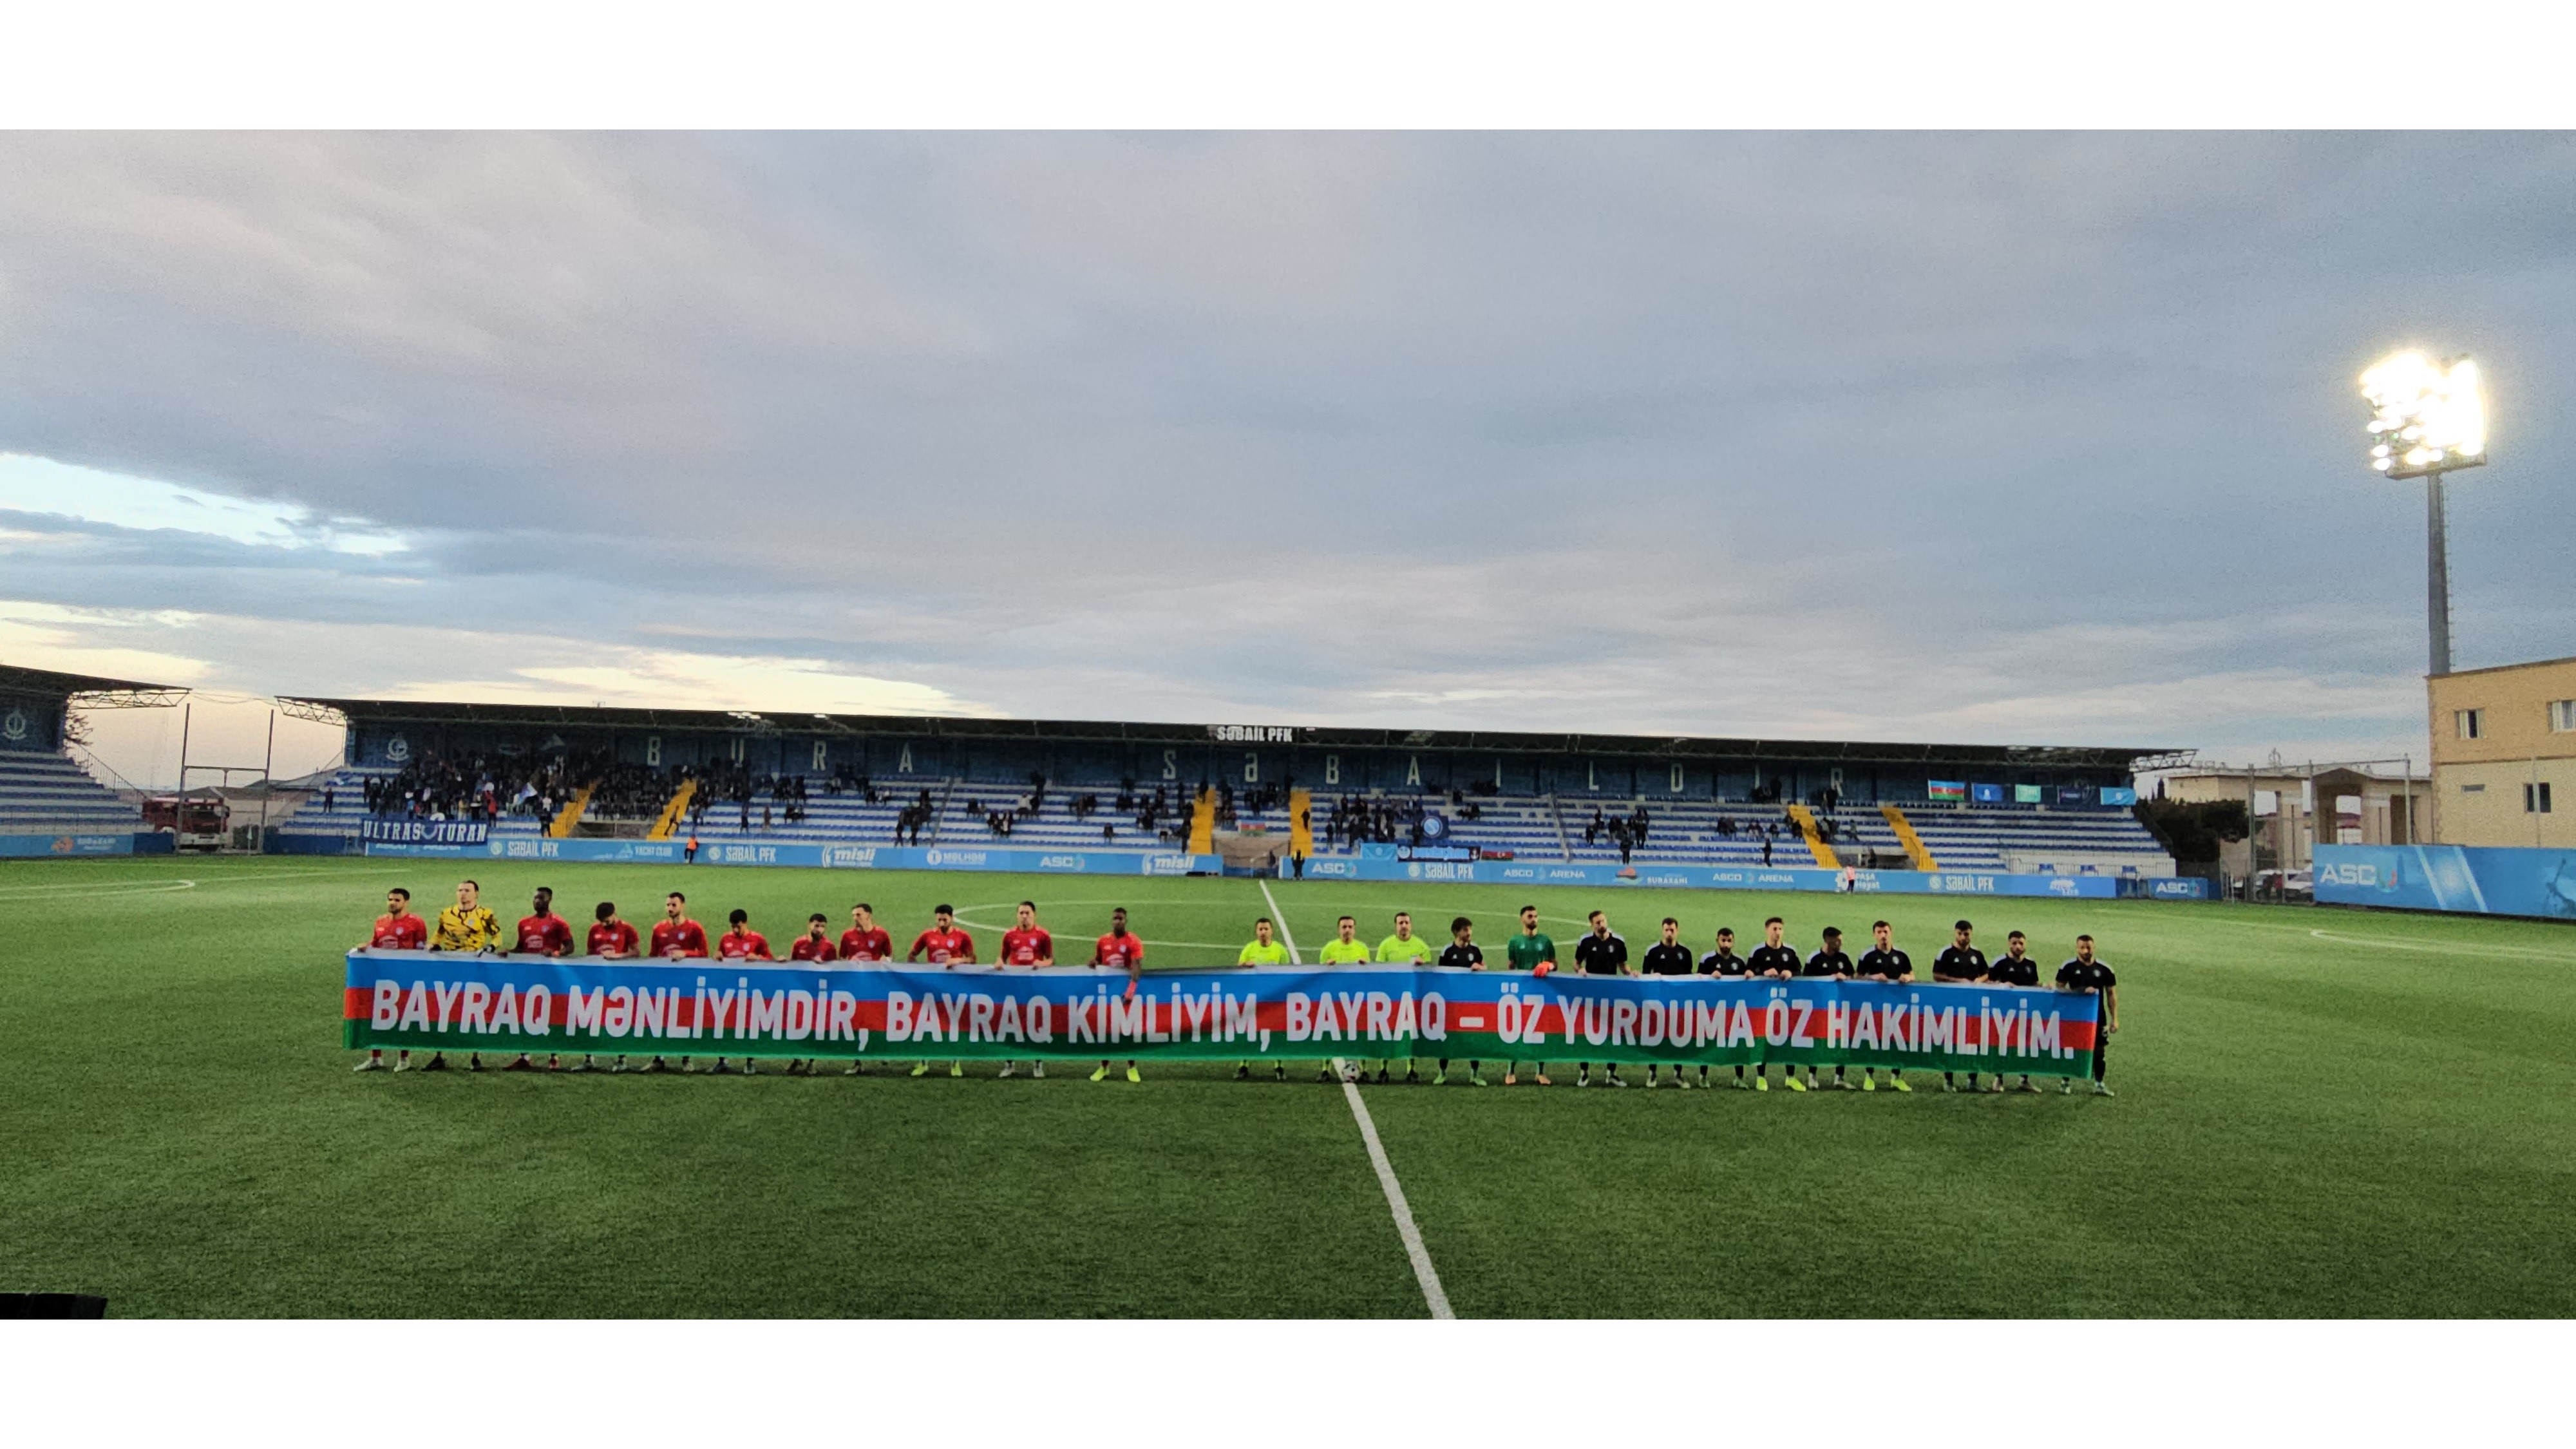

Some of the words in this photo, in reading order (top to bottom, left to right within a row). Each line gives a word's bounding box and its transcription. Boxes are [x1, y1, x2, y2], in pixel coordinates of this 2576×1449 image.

[1268, 727, 1293, 742] PFK
[363, 820, 421, 840] ULTRAS
[437, 823, 488, 842] TURAN
[542, 842, 559, 857] PFK
[759, 848, 776, 862] PFK
[1458, 864, 1474, 879] PFK
[1550, 870, 1585, 878] ARENA
[1759, 874, 1794, 882] ARENA
[1978, 877, 1994, 891] PFK
[372, 979, 551, 1036] BAYRAQ
[566, 976, 869, 1052] MƏNLİYİMDİR,
[886, 991, 1054, 1043] BAYRAQ
[1067, 982, 1270, 1052] KİMLİYİM,
[1287, 991, 1447, 1042] BAYRAQ
[1497, 982, 1545, 1044] ÖZ
[1557, 995, 1755, 1048] YURDUMA
[1765, 987, 1814, 1048] ÖZ
[1827, 992, 2074, 1059] HAKİMLİYİM.
